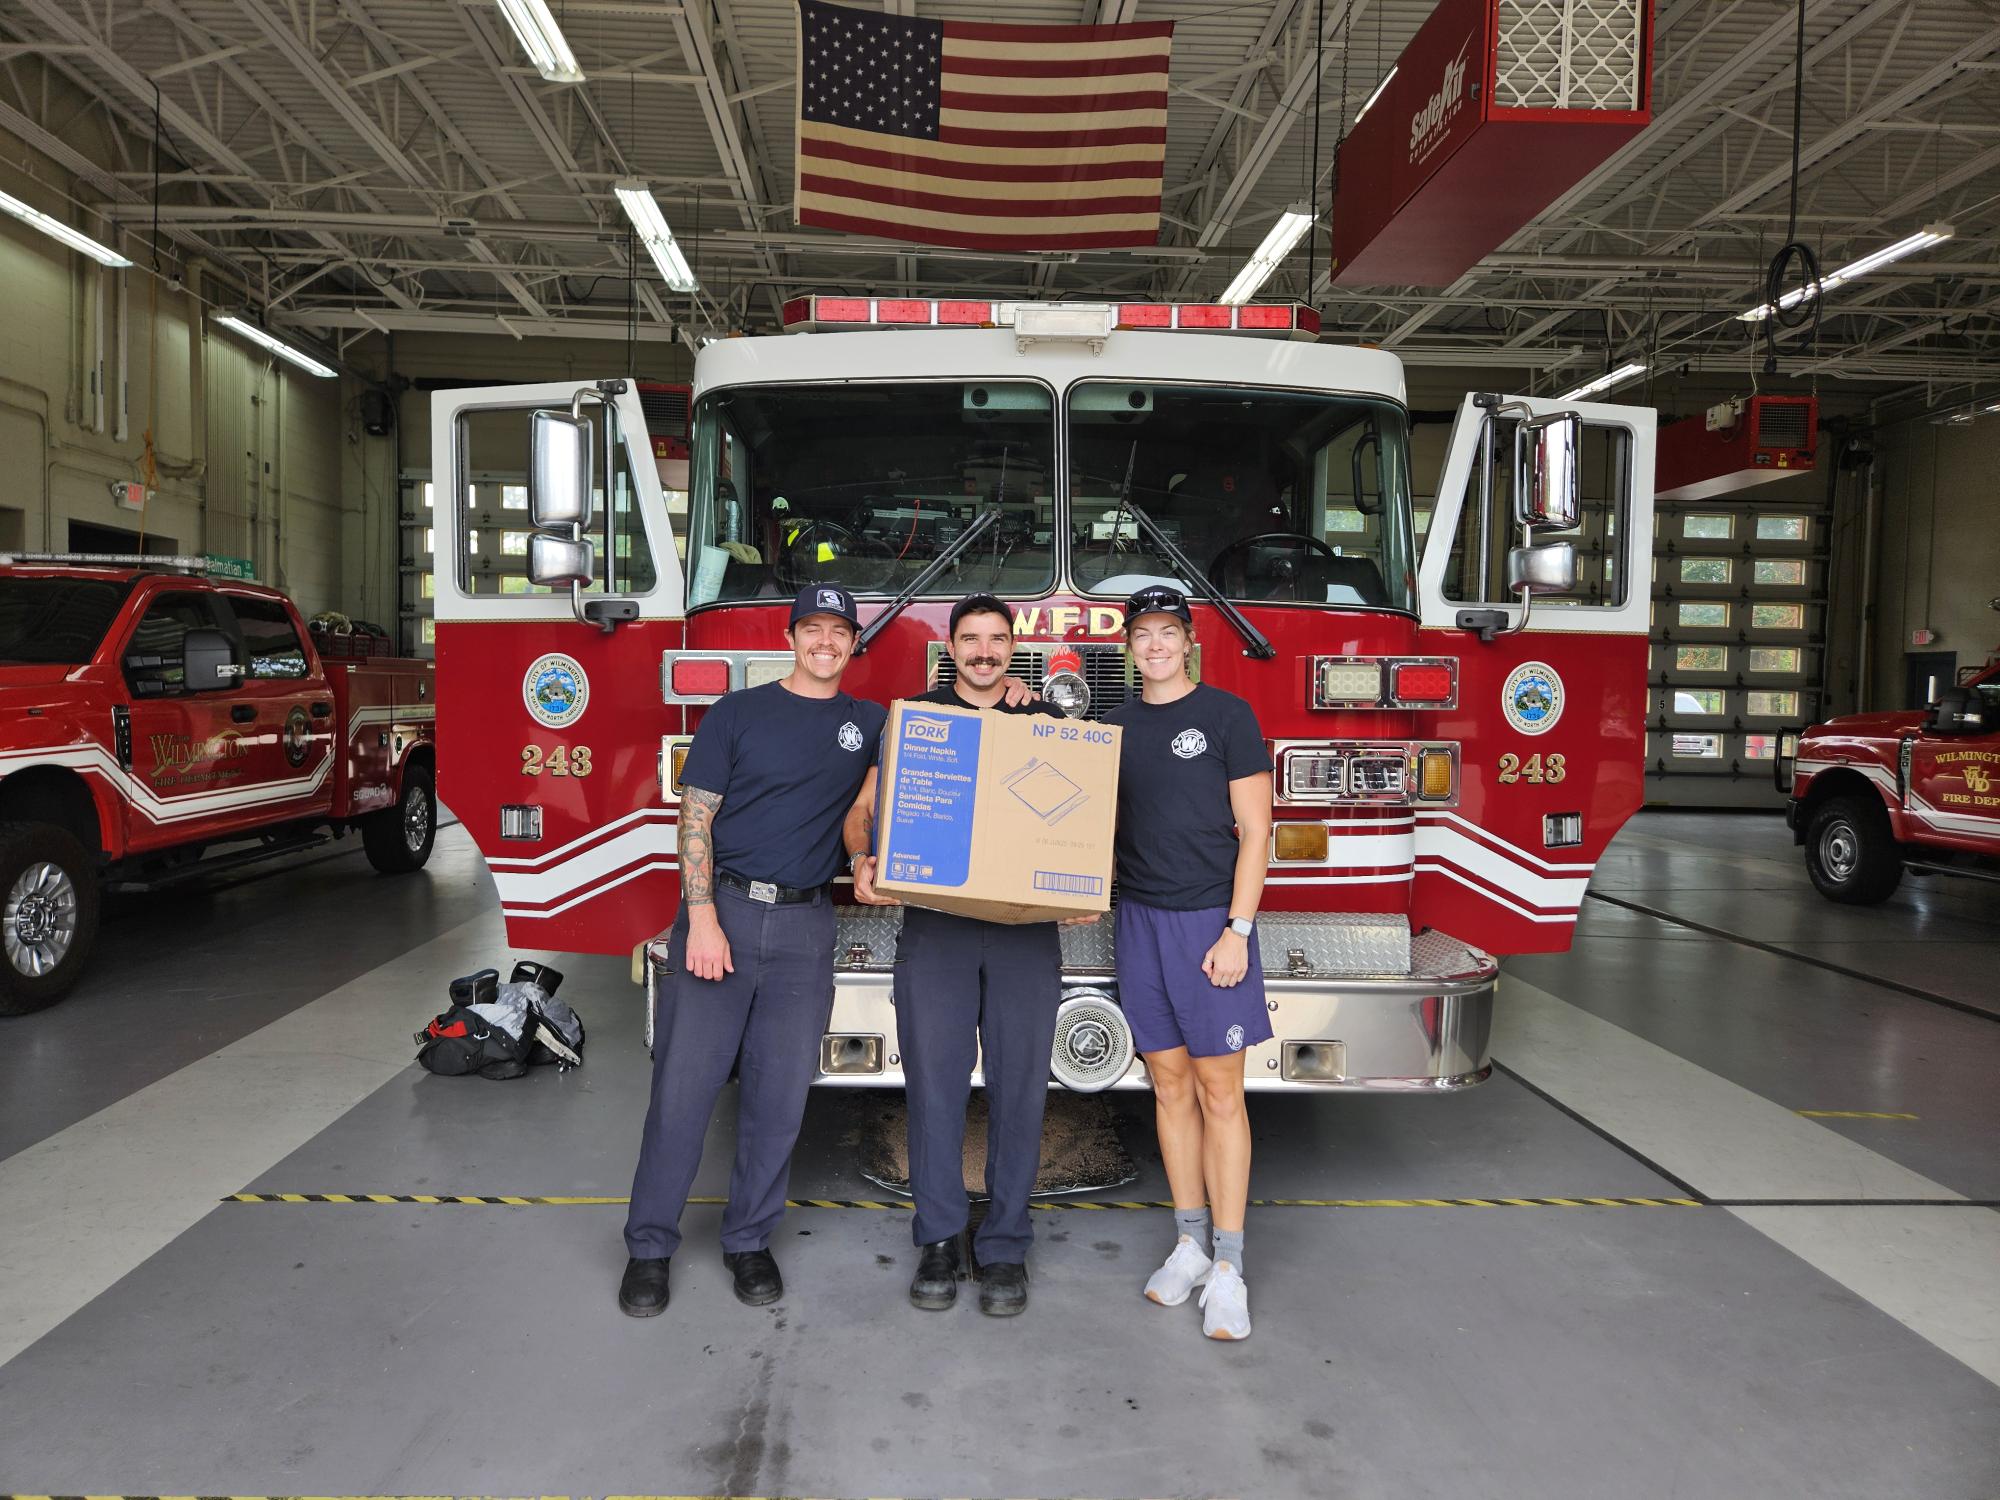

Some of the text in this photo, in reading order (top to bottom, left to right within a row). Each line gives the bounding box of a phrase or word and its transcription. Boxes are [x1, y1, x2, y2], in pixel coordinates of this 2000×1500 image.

[551, 660, 581, 685] WILMINGTON
[1529, 668, 1558, 693] WILMINGTON
[908, 724, 946, 739] TORK
[1032, 724, 1113, 744] NP 52 40C
[903, 743, 956, 757] Dinner Napkin
[521, 744, 593, 777] 243
[901, 767, 973, 783] Grandes Serviettes
[1498, 753, 1566, 784] 243
[912, 778, 933, 787] Table
[898, 800, 932, 811] Comidas
[899, 792, 953, 805] Servilleta Para
[1942, 793, 1971, 803] FIRE
[892, 851, 920, 860] Advanced
